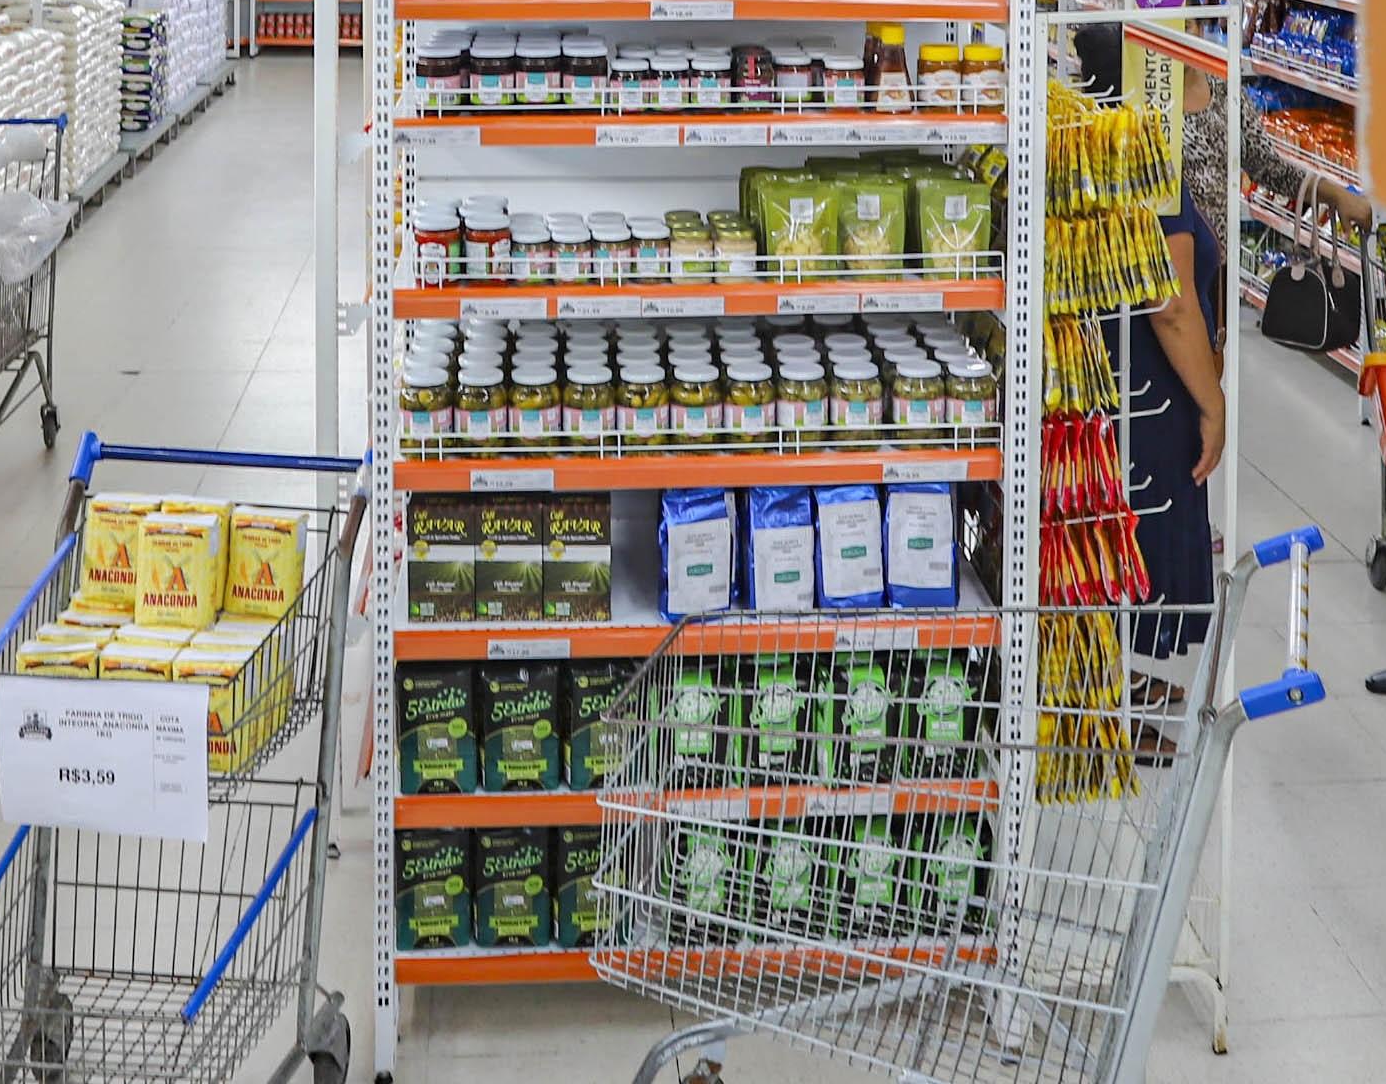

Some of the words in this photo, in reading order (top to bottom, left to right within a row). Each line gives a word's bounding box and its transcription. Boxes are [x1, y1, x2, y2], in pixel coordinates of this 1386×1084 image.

[88, 568, 137, 585] ANACOND
[142, 593, 198, 608] ANACONDA
[231, 586, 285, 603] ANACONDA
[58, 768, 115, 786] R$3,59
